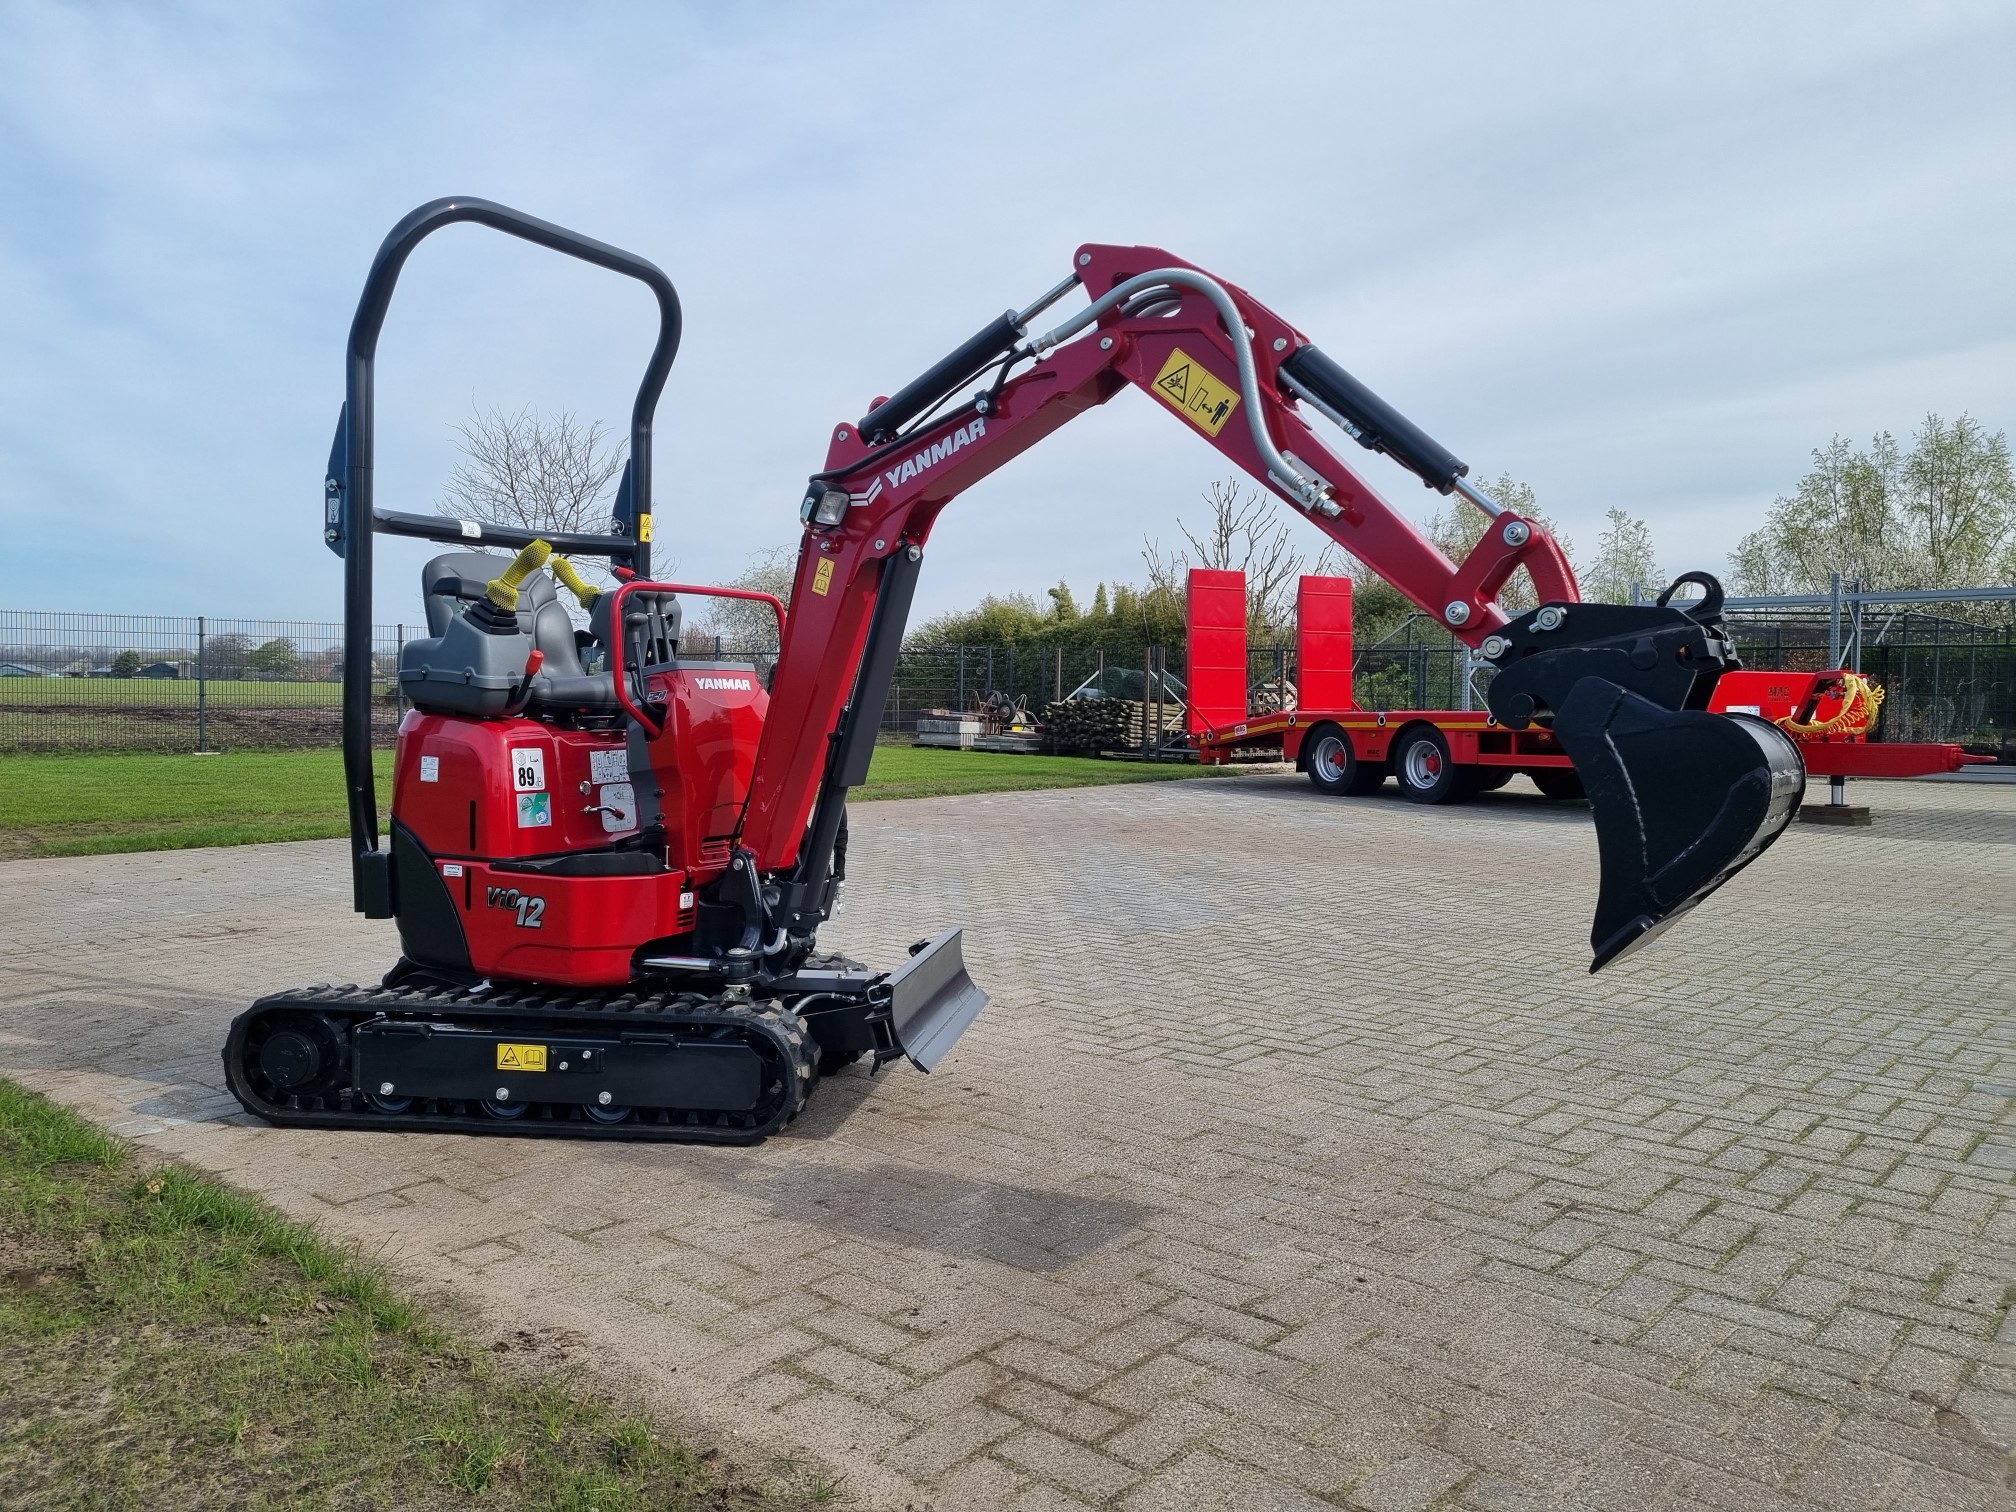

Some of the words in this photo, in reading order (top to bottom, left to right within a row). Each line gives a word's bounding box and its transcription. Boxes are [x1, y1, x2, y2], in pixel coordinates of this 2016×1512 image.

[885, 417, 986, 488] YANMAR
[695, 678, 751, 690] YANMAR
[518, 766, 535, 786] 89
